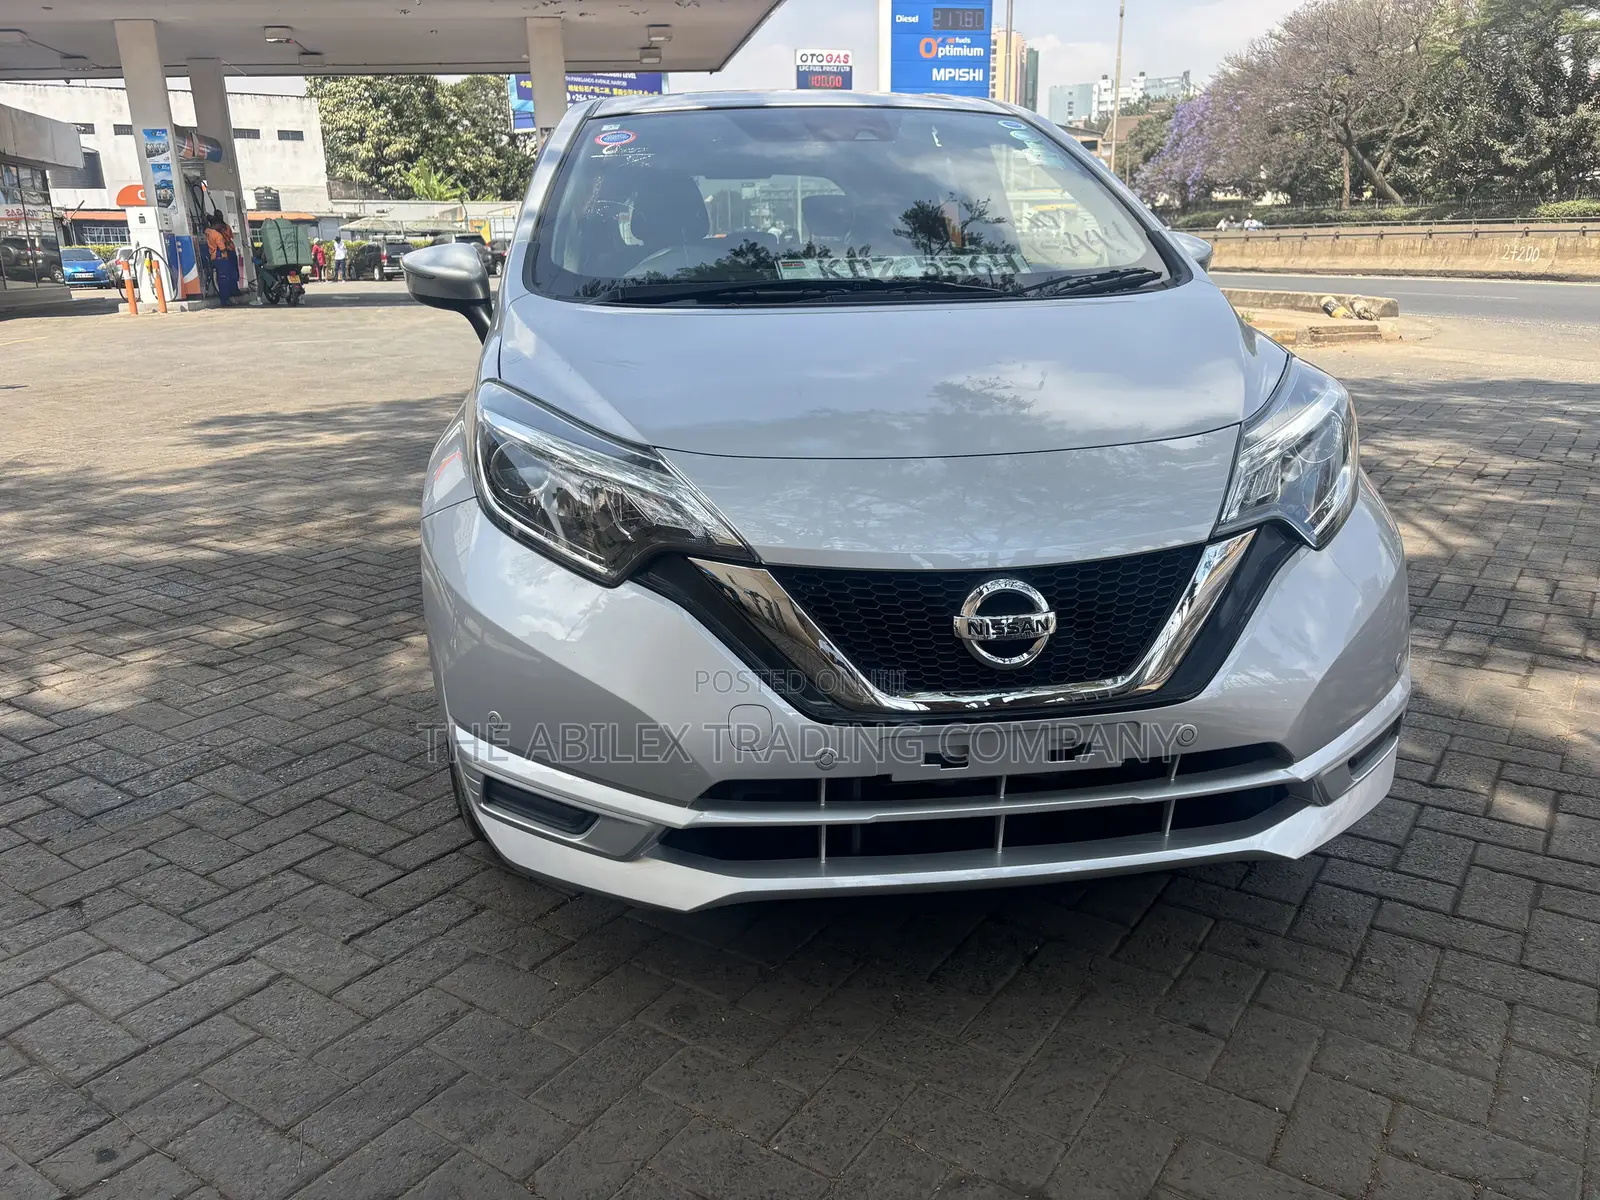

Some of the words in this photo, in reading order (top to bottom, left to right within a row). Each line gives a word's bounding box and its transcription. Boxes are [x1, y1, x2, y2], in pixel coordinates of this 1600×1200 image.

[896, 14, 919, 23] Diesel
[799, 53, 850, 64] OTOGAS
[931, 67, 984, 82] MPISHI
[966, 617, 1051, 637] NISSAN
